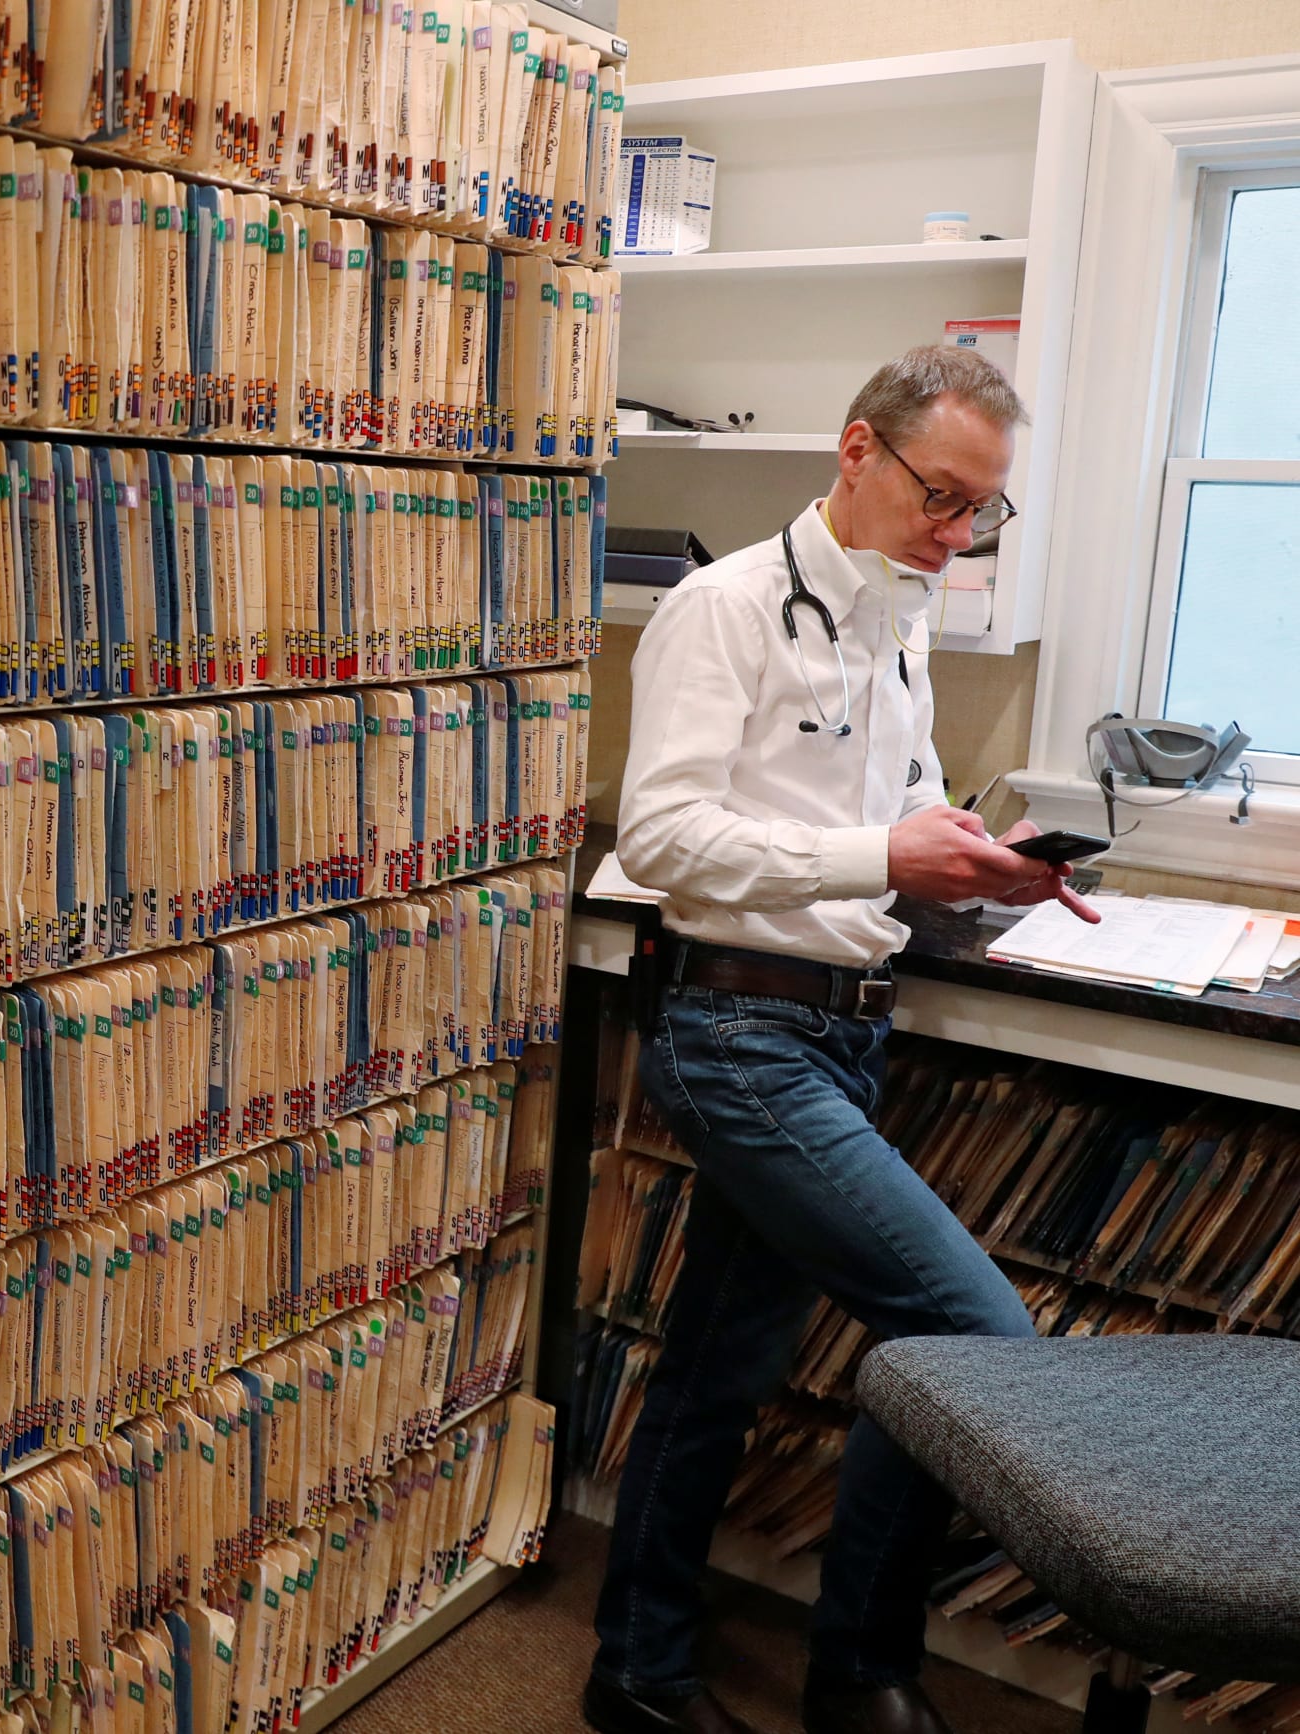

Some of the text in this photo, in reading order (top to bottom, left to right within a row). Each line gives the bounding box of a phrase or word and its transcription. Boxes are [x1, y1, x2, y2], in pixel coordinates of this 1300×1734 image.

[461, 337, 472, 365] Anna
[45, 801, 55, 846] Putnam
[210, 1013, 222, 1067] Roth, Noah
